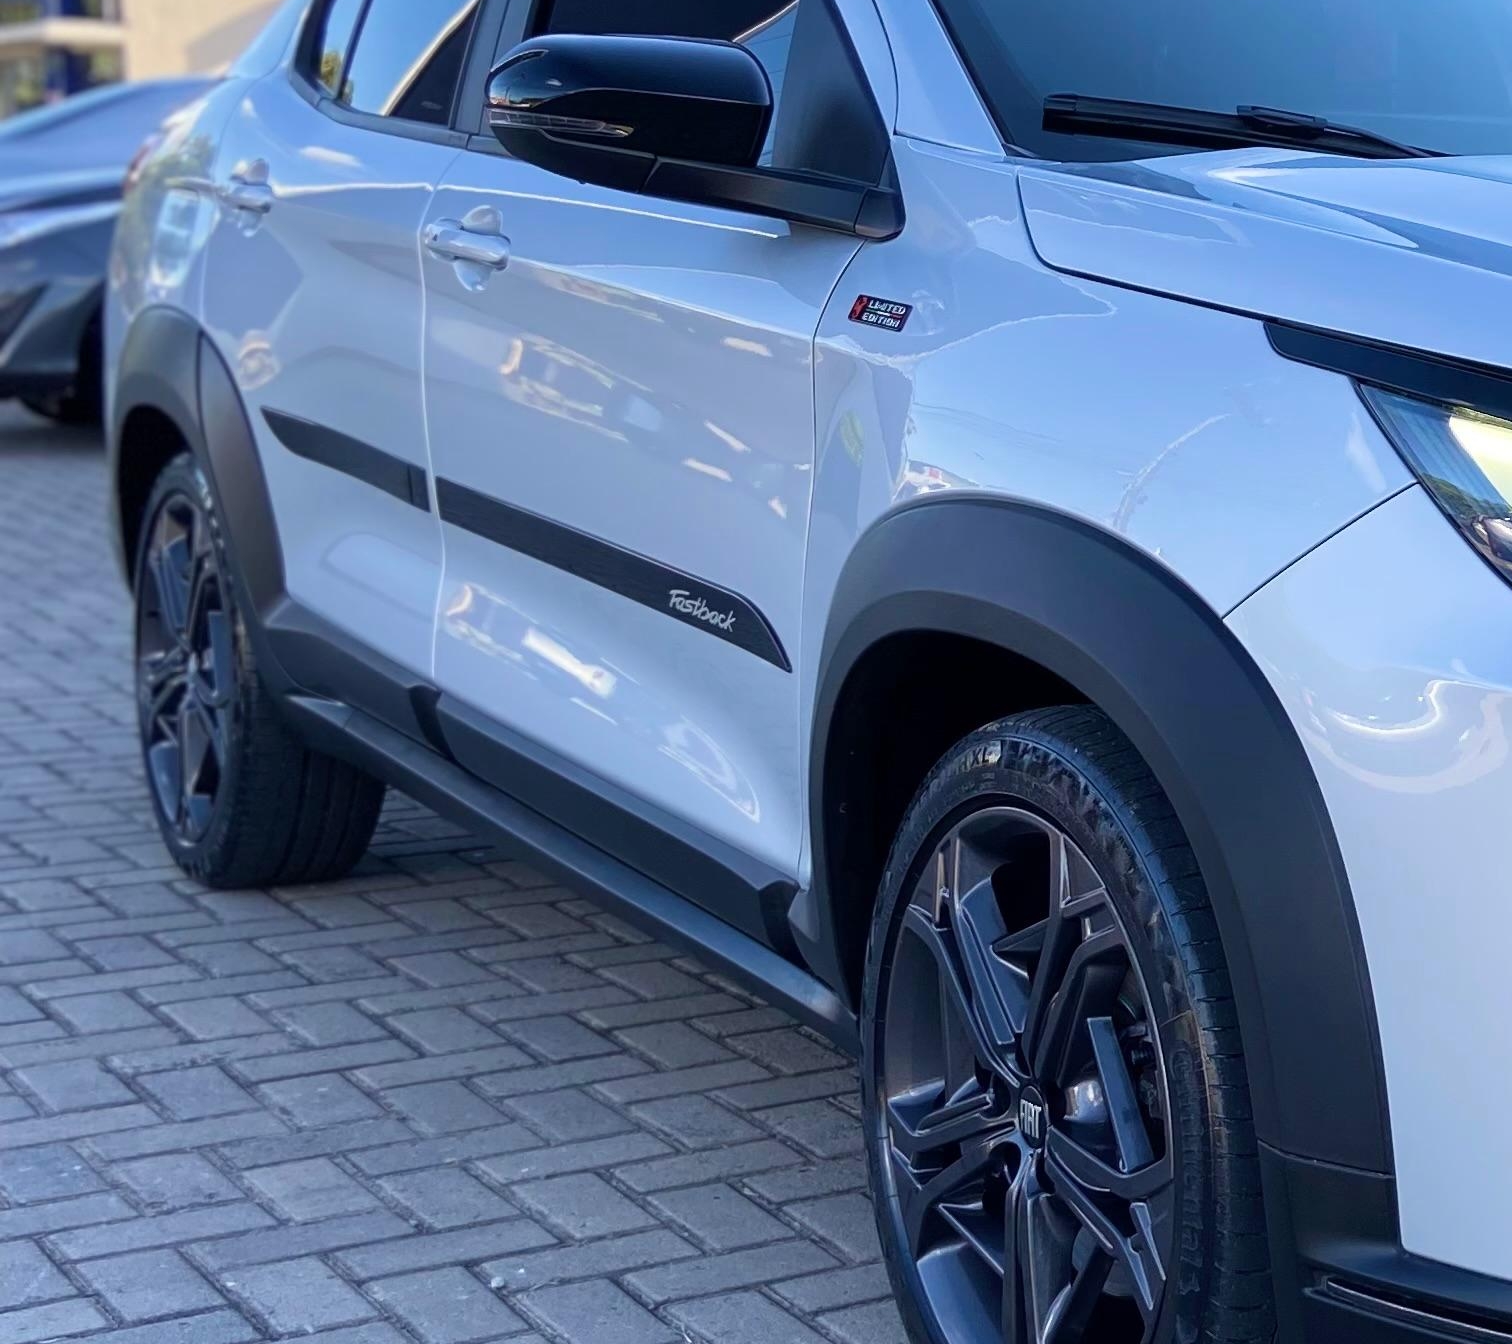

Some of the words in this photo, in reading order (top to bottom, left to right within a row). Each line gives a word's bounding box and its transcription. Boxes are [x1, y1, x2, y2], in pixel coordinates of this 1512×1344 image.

[861, 312, 901, 328] EDITION
[868, 299, 907, 315] LIMITED
[669, 589, 737, 633] Fastback
[1020, 1098, 1042, 1139] FIAT
